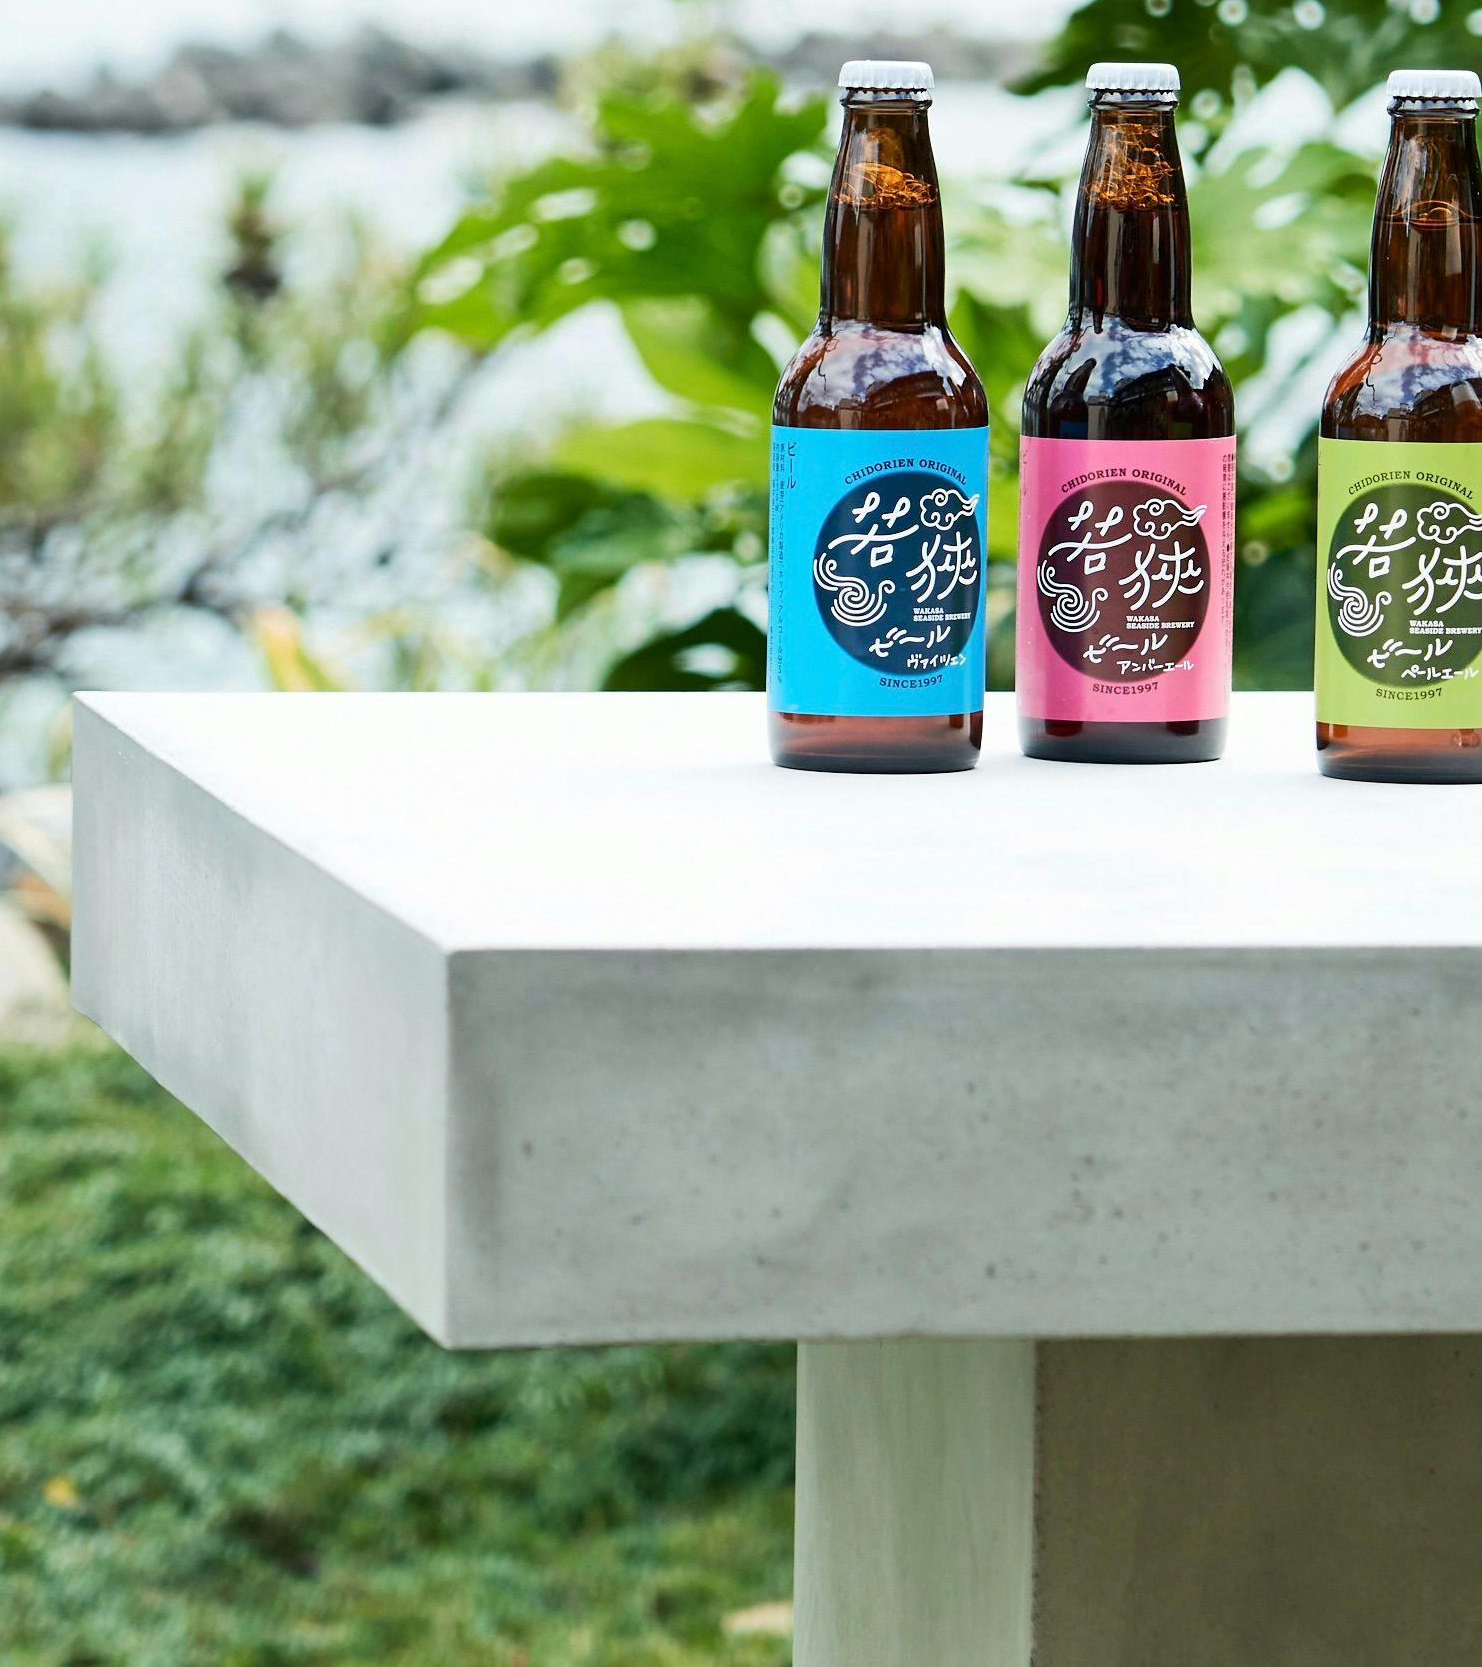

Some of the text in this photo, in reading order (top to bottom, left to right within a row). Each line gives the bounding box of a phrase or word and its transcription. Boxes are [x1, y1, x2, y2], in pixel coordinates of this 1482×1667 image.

[787, 441, 797, 489] ビール
[844, 458, 966, 486] CHIDORIEN ORIGINAL
[1061, 468, 1187, 497] CHIDORIEN ORIGINAL
[1348, 470, 1474, 500] CHIDORIEN ORIGINAL
[913, 612, 971, 622] SEASIDE BREWERY
[1126, 621, 1195, 630] SEASIDE BREWERY
[1409, 627, 1482, 635] SEASIDE BREWERY
[869, 624, 951, 658] ビール
[1083, 633, 1168, 664] ビール
[1367, 638, 1453, 669] ビール
[906, 654, 967, 669] ヴァイツェン
[1116, 659, 1195, 674] アンバーエール
[879, 674, 944, 689] SINCE1997
[1401, 667, 1479, 681] ペールエール
[1092, 681, 1159, 695] SINCE1997
[1375, 687, 1443, 701] SINCE1997
